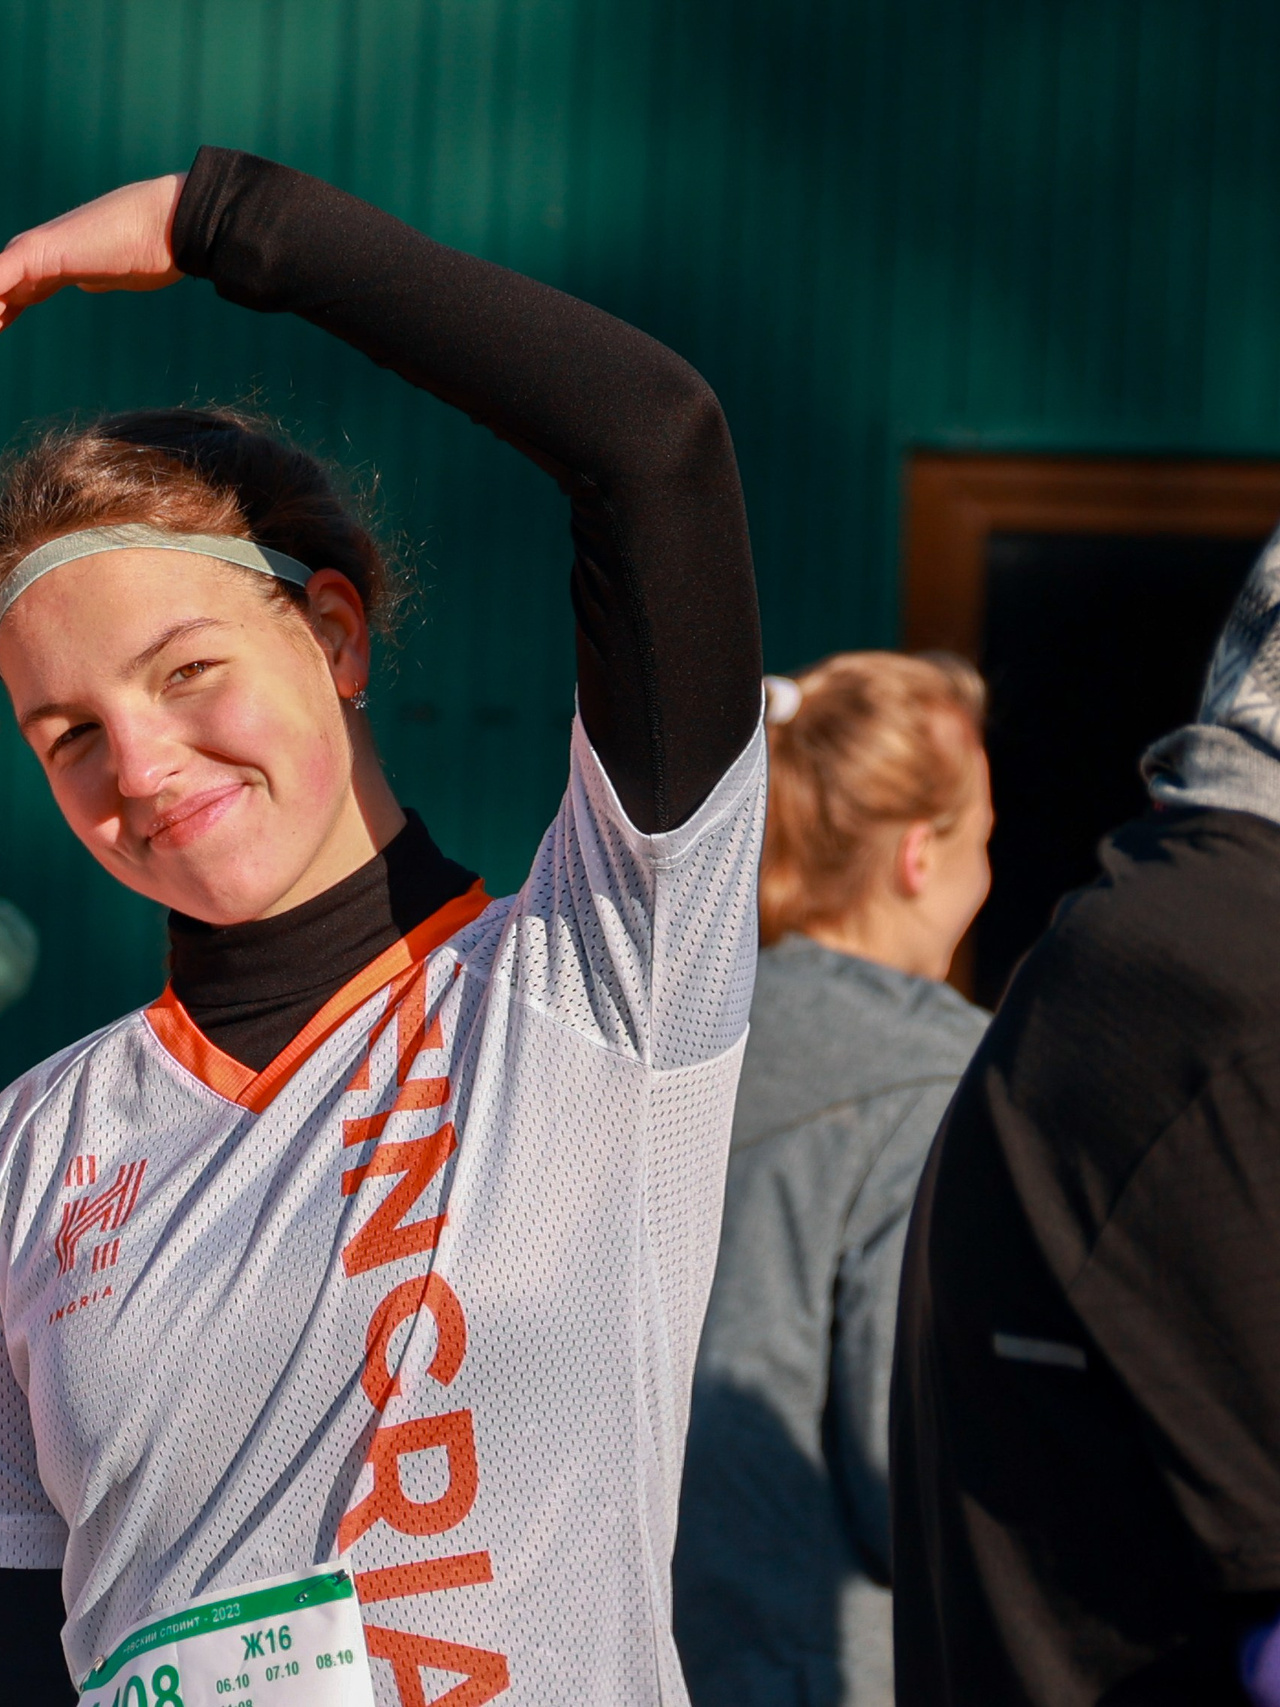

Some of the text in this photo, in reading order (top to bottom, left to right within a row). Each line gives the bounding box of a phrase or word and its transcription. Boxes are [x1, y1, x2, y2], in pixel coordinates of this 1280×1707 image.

[48, 1285, 113, 1325] INGRIA
[211, 1603, 241, 1622] 2023
[241, 1625, 292, 1660] Ж16
[216, 1649, 353, 1694] 06.10 07.10 08.10
